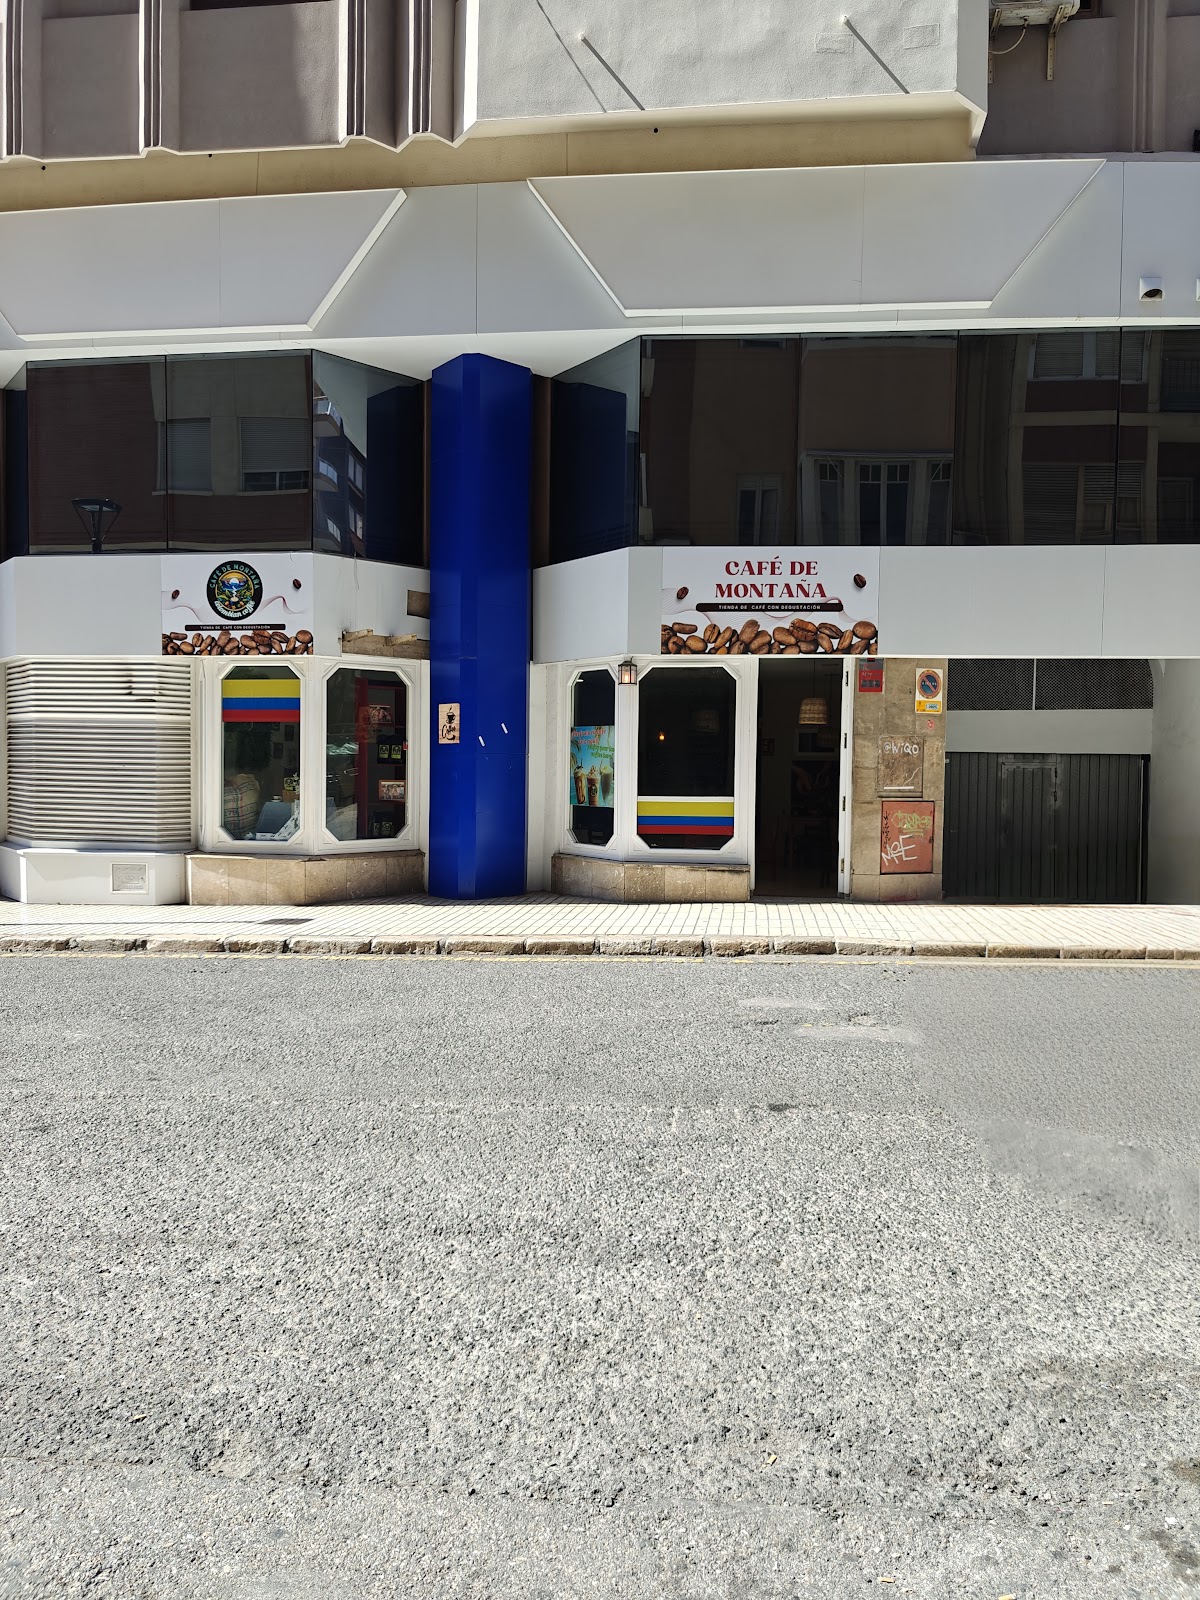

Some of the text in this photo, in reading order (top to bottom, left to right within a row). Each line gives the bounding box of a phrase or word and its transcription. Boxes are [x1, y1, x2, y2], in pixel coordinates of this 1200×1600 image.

[725, 555, 818, 576] CAFÉ DE
[210, 570, 221, 588] CAFÉ
[233, 564, 260, 589] MONTAÑA
[715, 578, 827, 598] MONTAÑA
